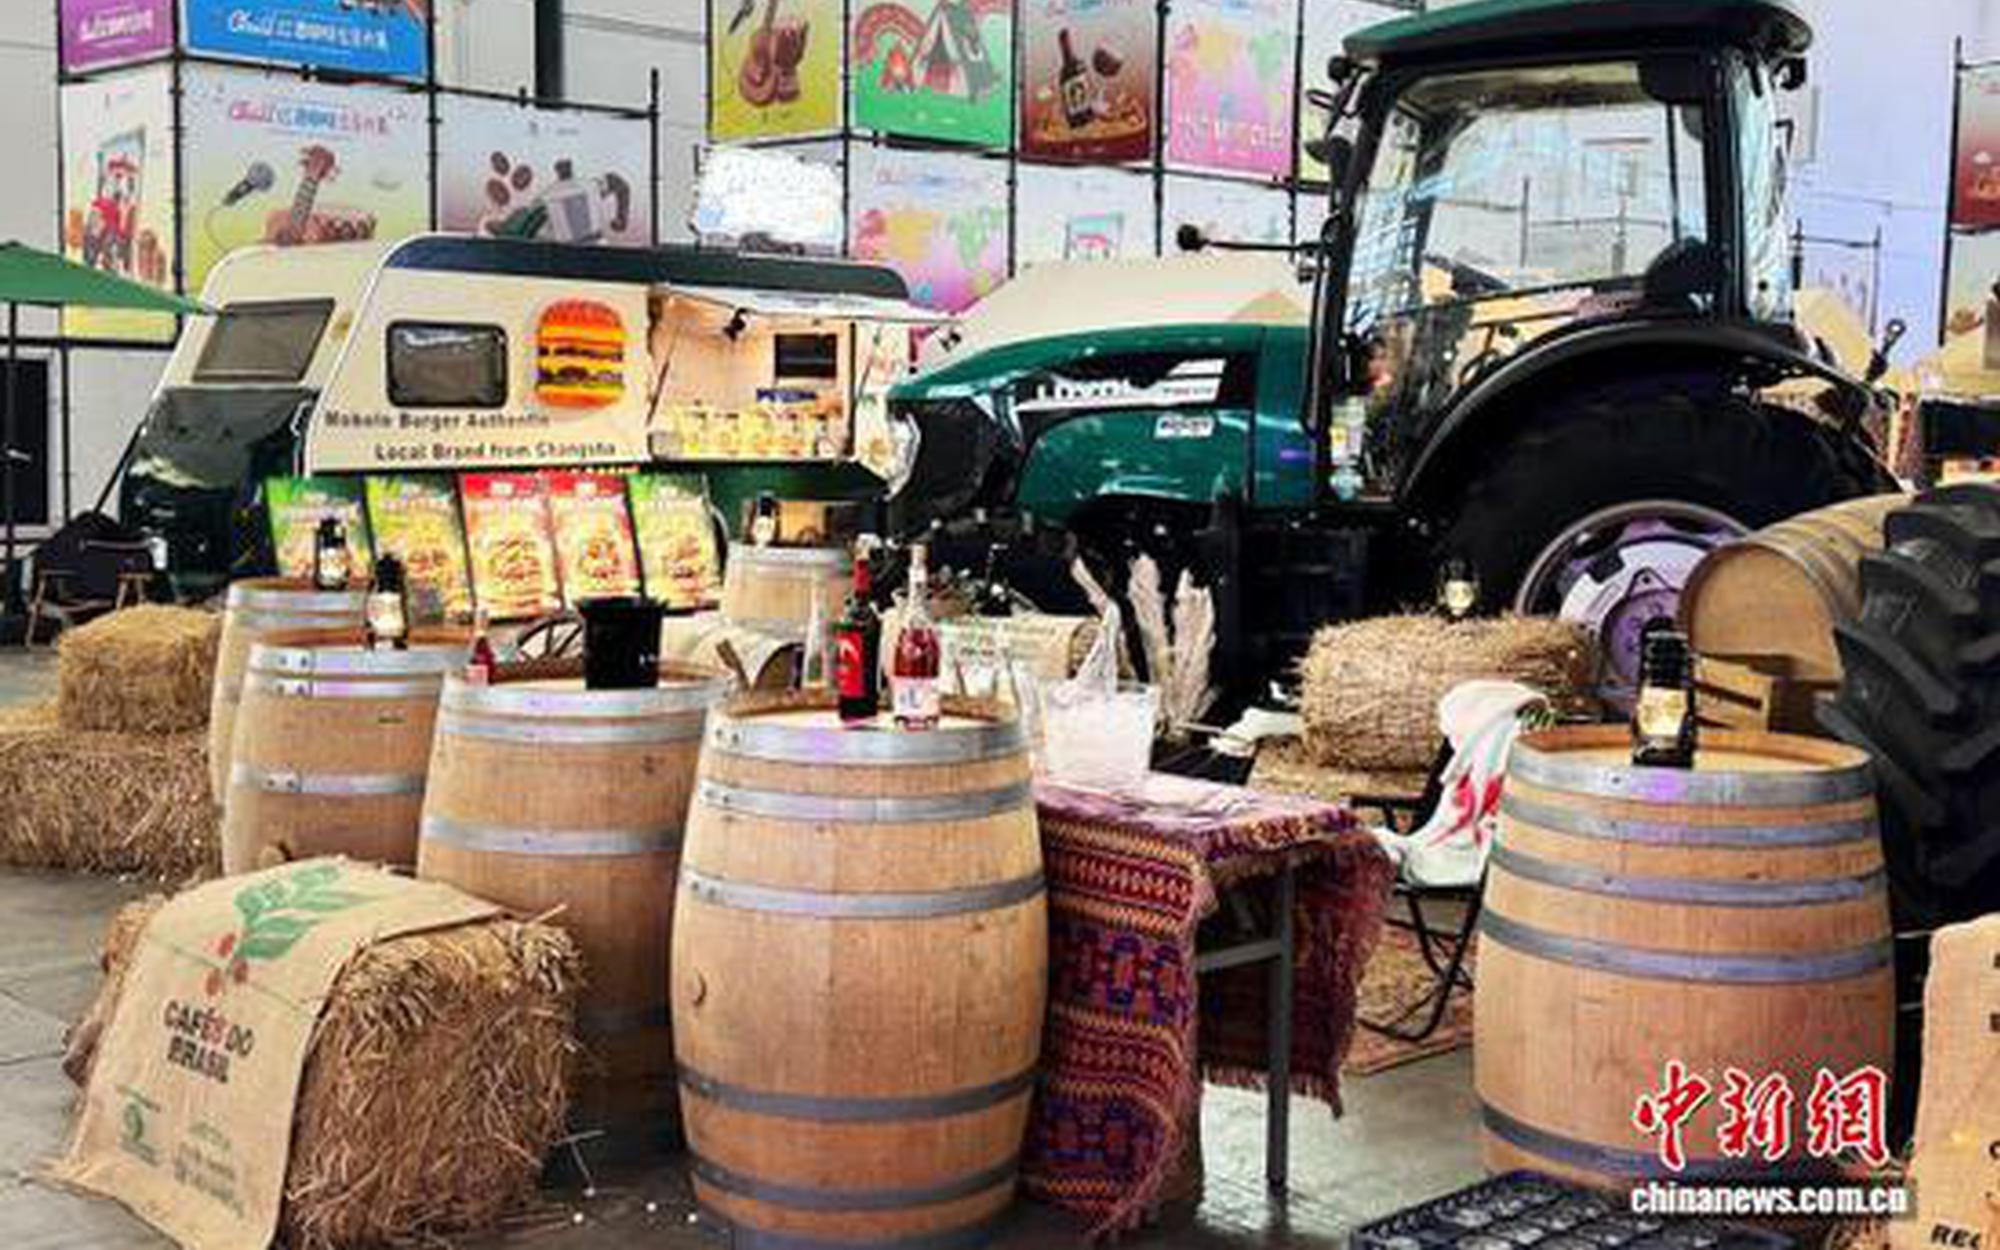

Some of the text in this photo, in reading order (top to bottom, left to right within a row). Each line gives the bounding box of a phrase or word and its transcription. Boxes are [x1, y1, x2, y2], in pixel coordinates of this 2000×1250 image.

[399, 412, 460, 431] Burger
[374, 442, 428, 460] Local
[432, 442, 485, 460] Brand
[490, 442, 531, 459] from
[224, 1024, 254, 1057] DO
[167, 1036, 230, 1083] BRASIL
